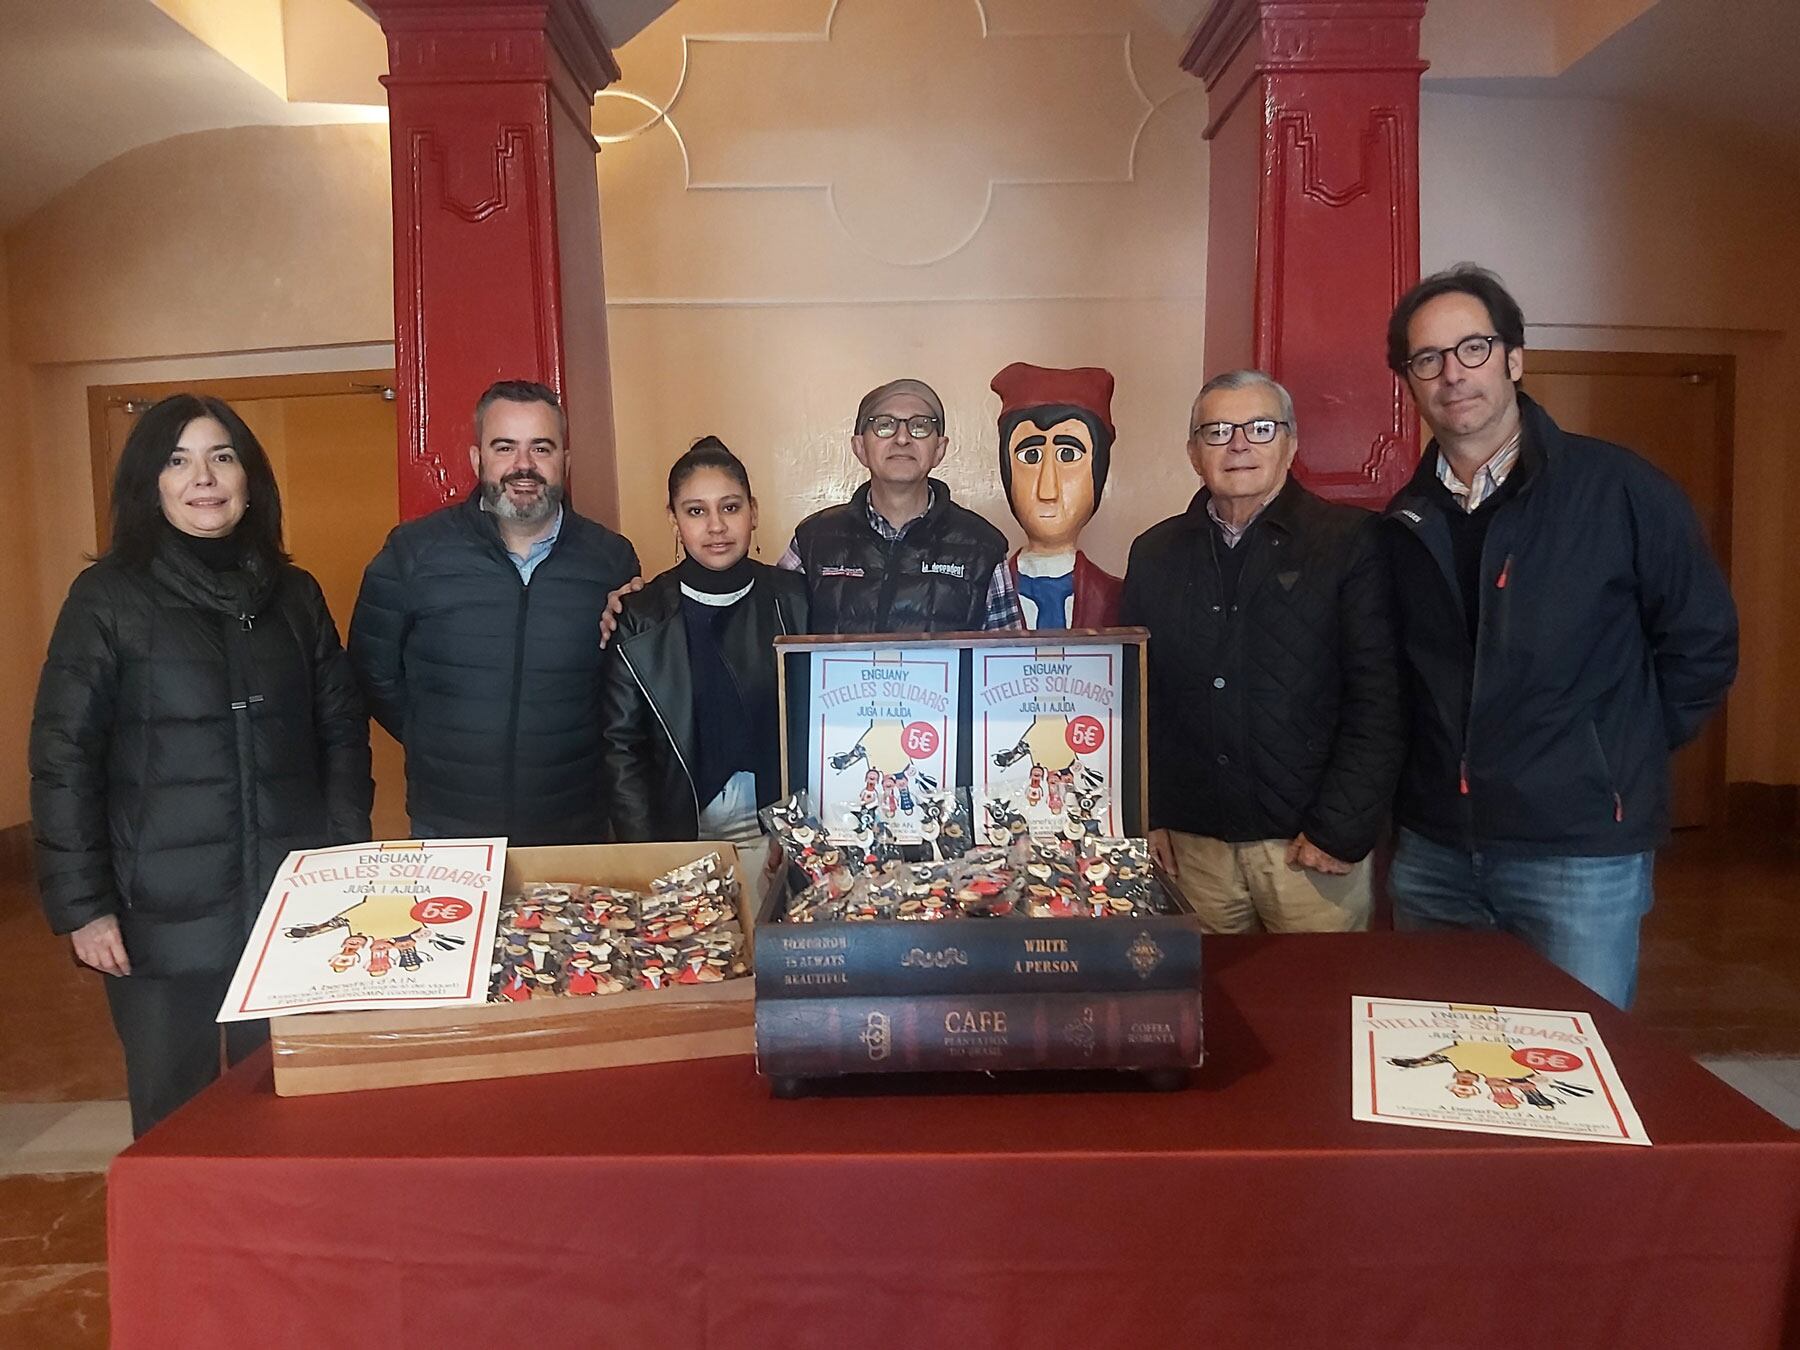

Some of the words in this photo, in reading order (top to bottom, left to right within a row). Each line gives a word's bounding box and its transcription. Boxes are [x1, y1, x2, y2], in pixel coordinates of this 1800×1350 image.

[861, 669, 909, 682] ENGUANY
[1023, 663, 1073, 676] ENGUANY
[819, 682, 877, 710] TITELLES
[883, 682, 949, 712] SOLIDARIS
[980, 676, 1039, 706] TITELLES
[1045, 675, 1115, 709] SOLIDARIS
[857, 707, 878, 718] JUGA
[886, 707, 912, 718] AJUDA
[1019, 702, 1041, 713] JUGA
[1049, 701, 1076, 713] AJUDA
[908, 731, 933, 751] 5€
[1072, 723, 1097, 747] 5€
[359, 853, 433, 865] ENGUANY
[284, 864, 379, 888] TITELLES
[389, 864, 494, 889] SOLIDARIS
[343, 885, 376, 894] JUGA
[391, 884, 431, 894] AJUDA
[421, 902, 464, 919] 5€
[1024, 939, 1068, 953] WHITE
[800, 954, 846, 968] ALWAYS
[1014, 961, 1022, 973] A
[1025, 960, 1079, 973] PERSON
[784, 973, 848, 985] BEAUTIFUL
[944, 1011, 1007, 1033] CAFE
[1363, 1017, 1460, 1030] TITELLES
[1470, 1020, 1588, 1045] SOLIDARIS
[1526, 1052, 1569, 1068] 5€
